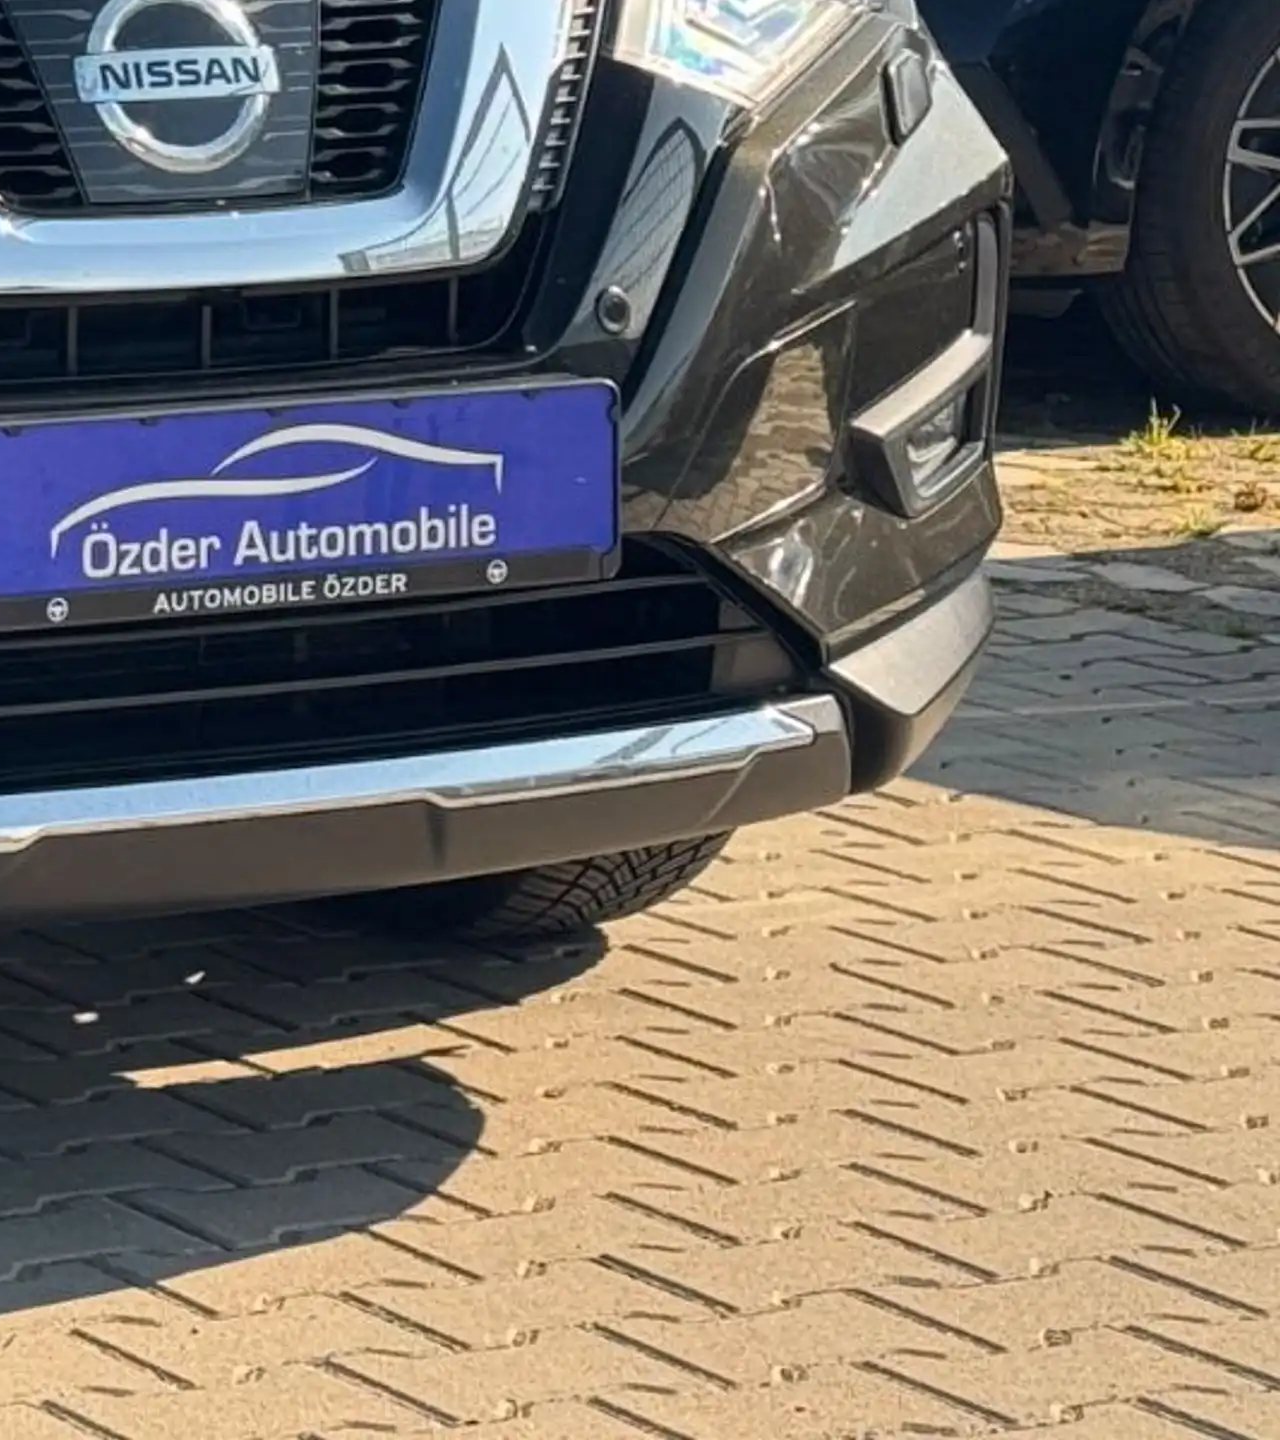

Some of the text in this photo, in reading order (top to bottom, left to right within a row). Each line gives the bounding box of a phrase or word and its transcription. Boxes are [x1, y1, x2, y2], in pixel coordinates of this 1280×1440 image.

[98, 55, 262, 93] NISSAN
[81, 504, 497, 580] Özder Automobile
[152, 572, 407, 614] AUTOMOBILE ÖZDER
